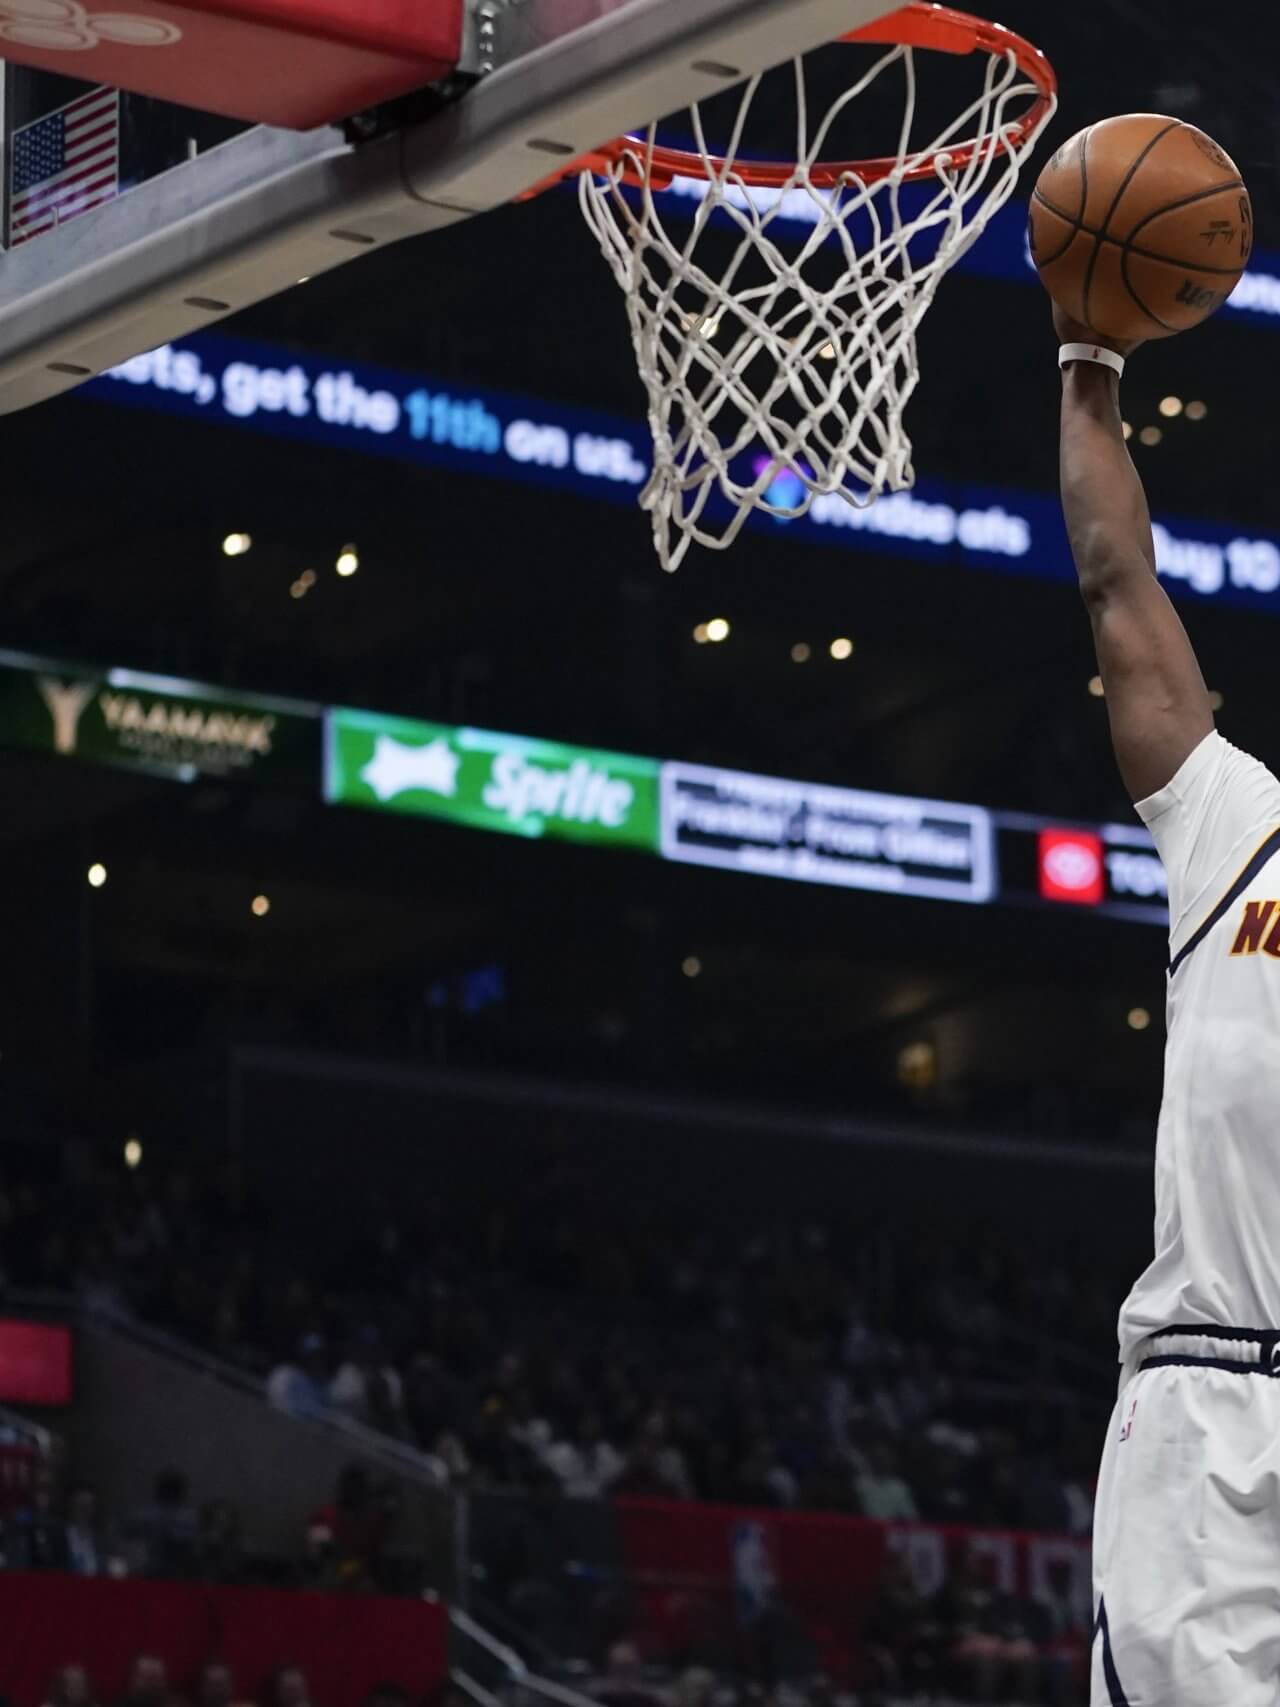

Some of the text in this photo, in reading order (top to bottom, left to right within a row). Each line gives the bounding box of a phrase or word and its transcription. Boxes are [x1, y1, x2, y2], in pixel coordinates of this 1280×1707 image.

[222, 362, 309, 417] get
[313, 372, 399, 434] the
[405, 391, 500, 452] 11th
[505, 419, 569, 467] on
[483, 750, 635, 827] Sprite
